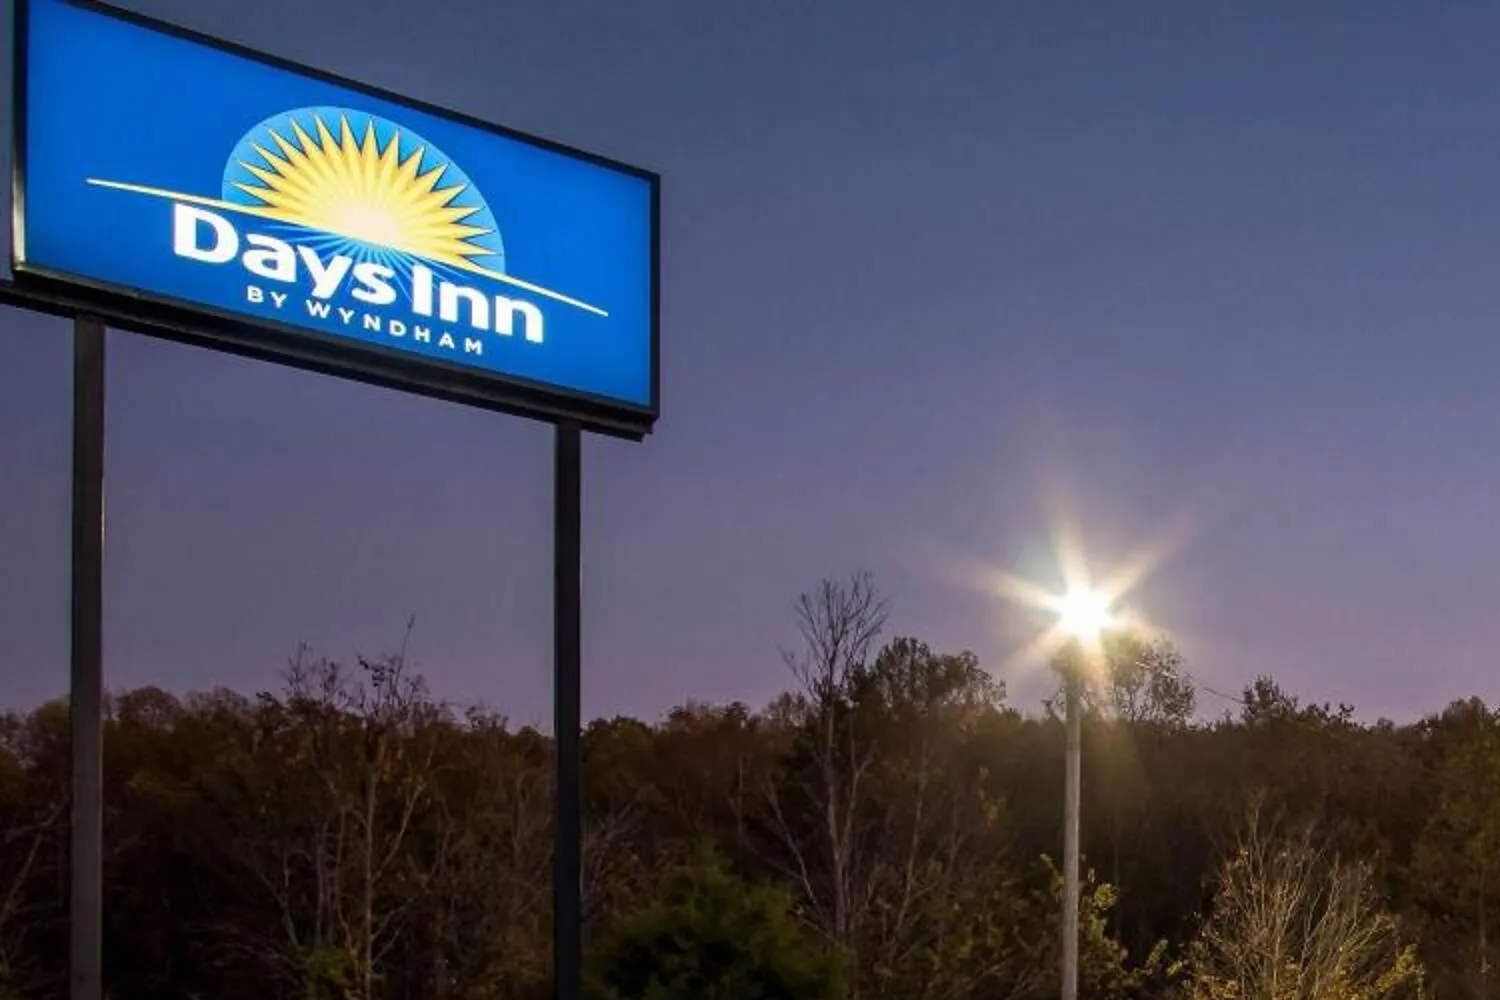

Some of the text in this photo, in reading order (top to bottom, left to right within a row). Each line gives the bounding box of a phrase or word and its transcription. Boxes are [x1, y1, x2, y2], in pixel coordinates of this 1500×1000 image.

[174, 202, 544, 343] Days Inn
[246, 285, 483, 355] BY WYNDHAM
